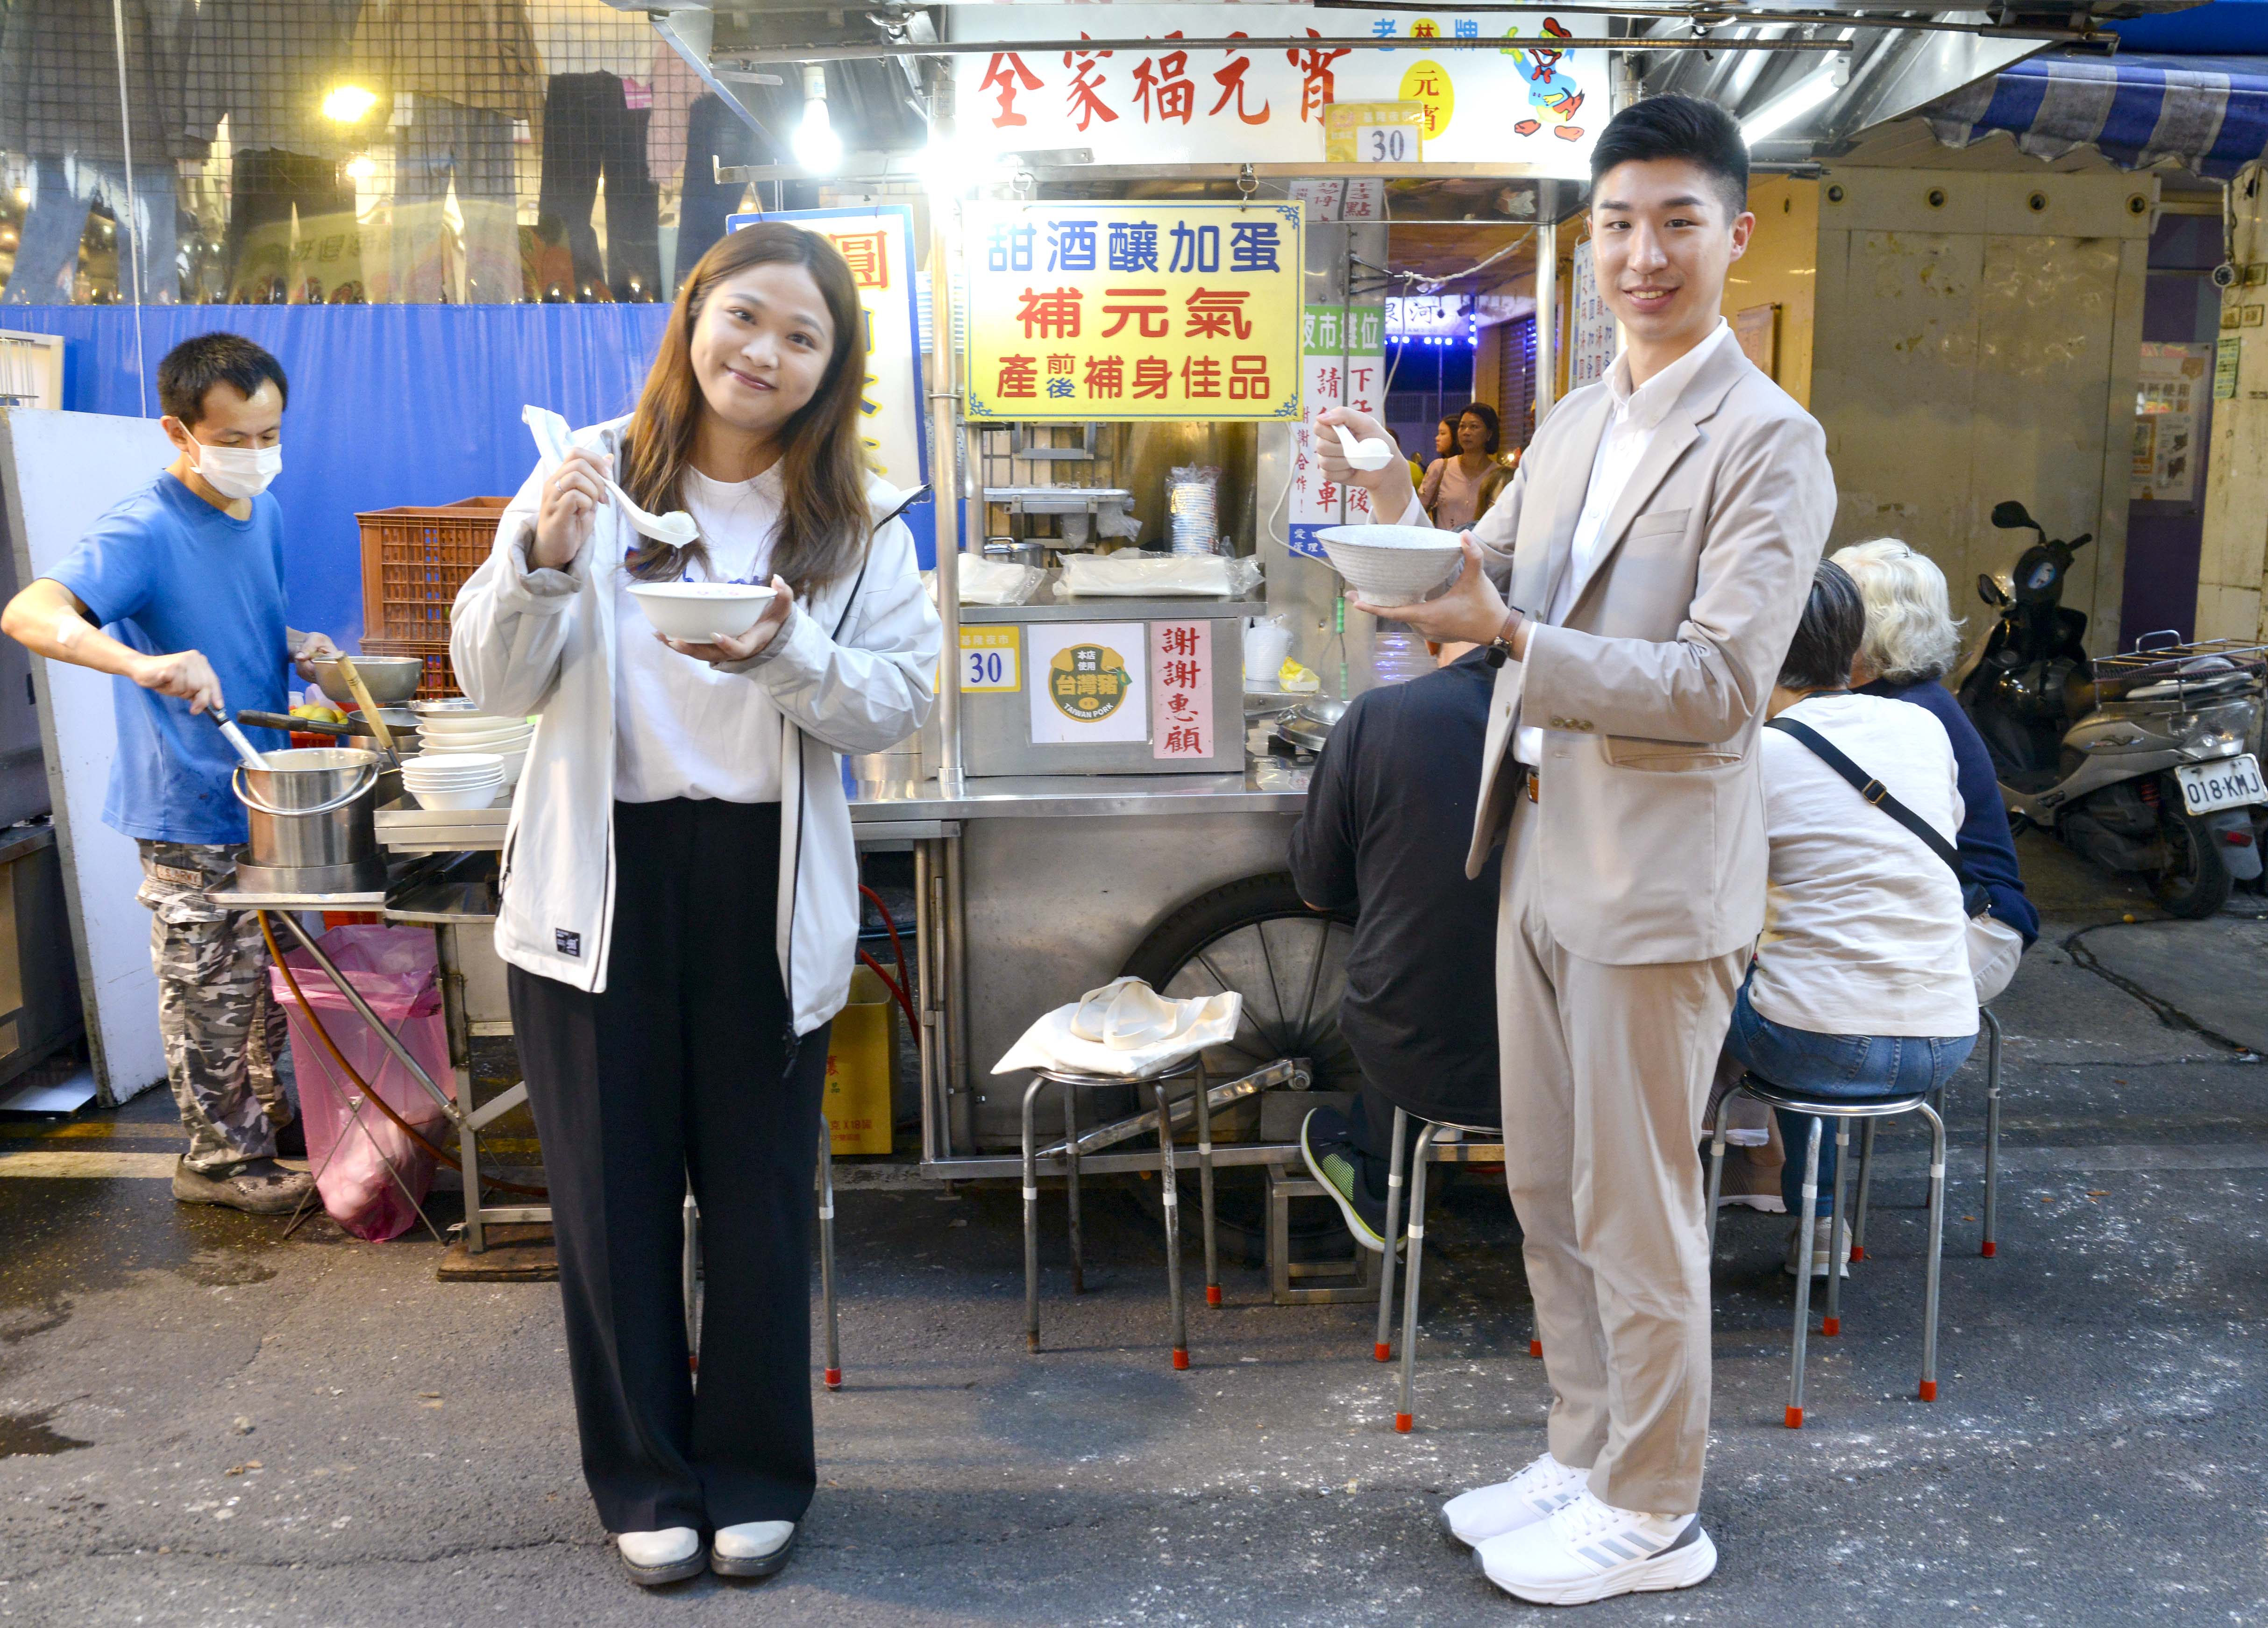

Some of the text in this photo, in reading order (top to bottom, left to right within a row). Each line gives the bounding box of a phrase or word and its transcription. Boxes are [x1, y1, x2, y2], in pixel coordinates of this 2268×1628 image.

[1372, 18, 1478, 51] 老林牌
[978, 27, 1351, 132] 全家福元宵
[1413, 70, 1440, 131] 元宵
[1372, 129, 1405, 162] 30
[988, 220, 1281, 273] 甜酒釀加蛋
[1017, 287, 1252, 340] 補元氣
[970, 652, 1002, 683] 30
[1077, 650, 1096, 660] 本店
[1077, 662, 1096, 671] 使用
[1056, 674, 1118, 695] 台灣豬
[1162, 627, 1202, 754] 謝謝惠顧
[1064, 703, 1114, 718] TAIWAN PORK
